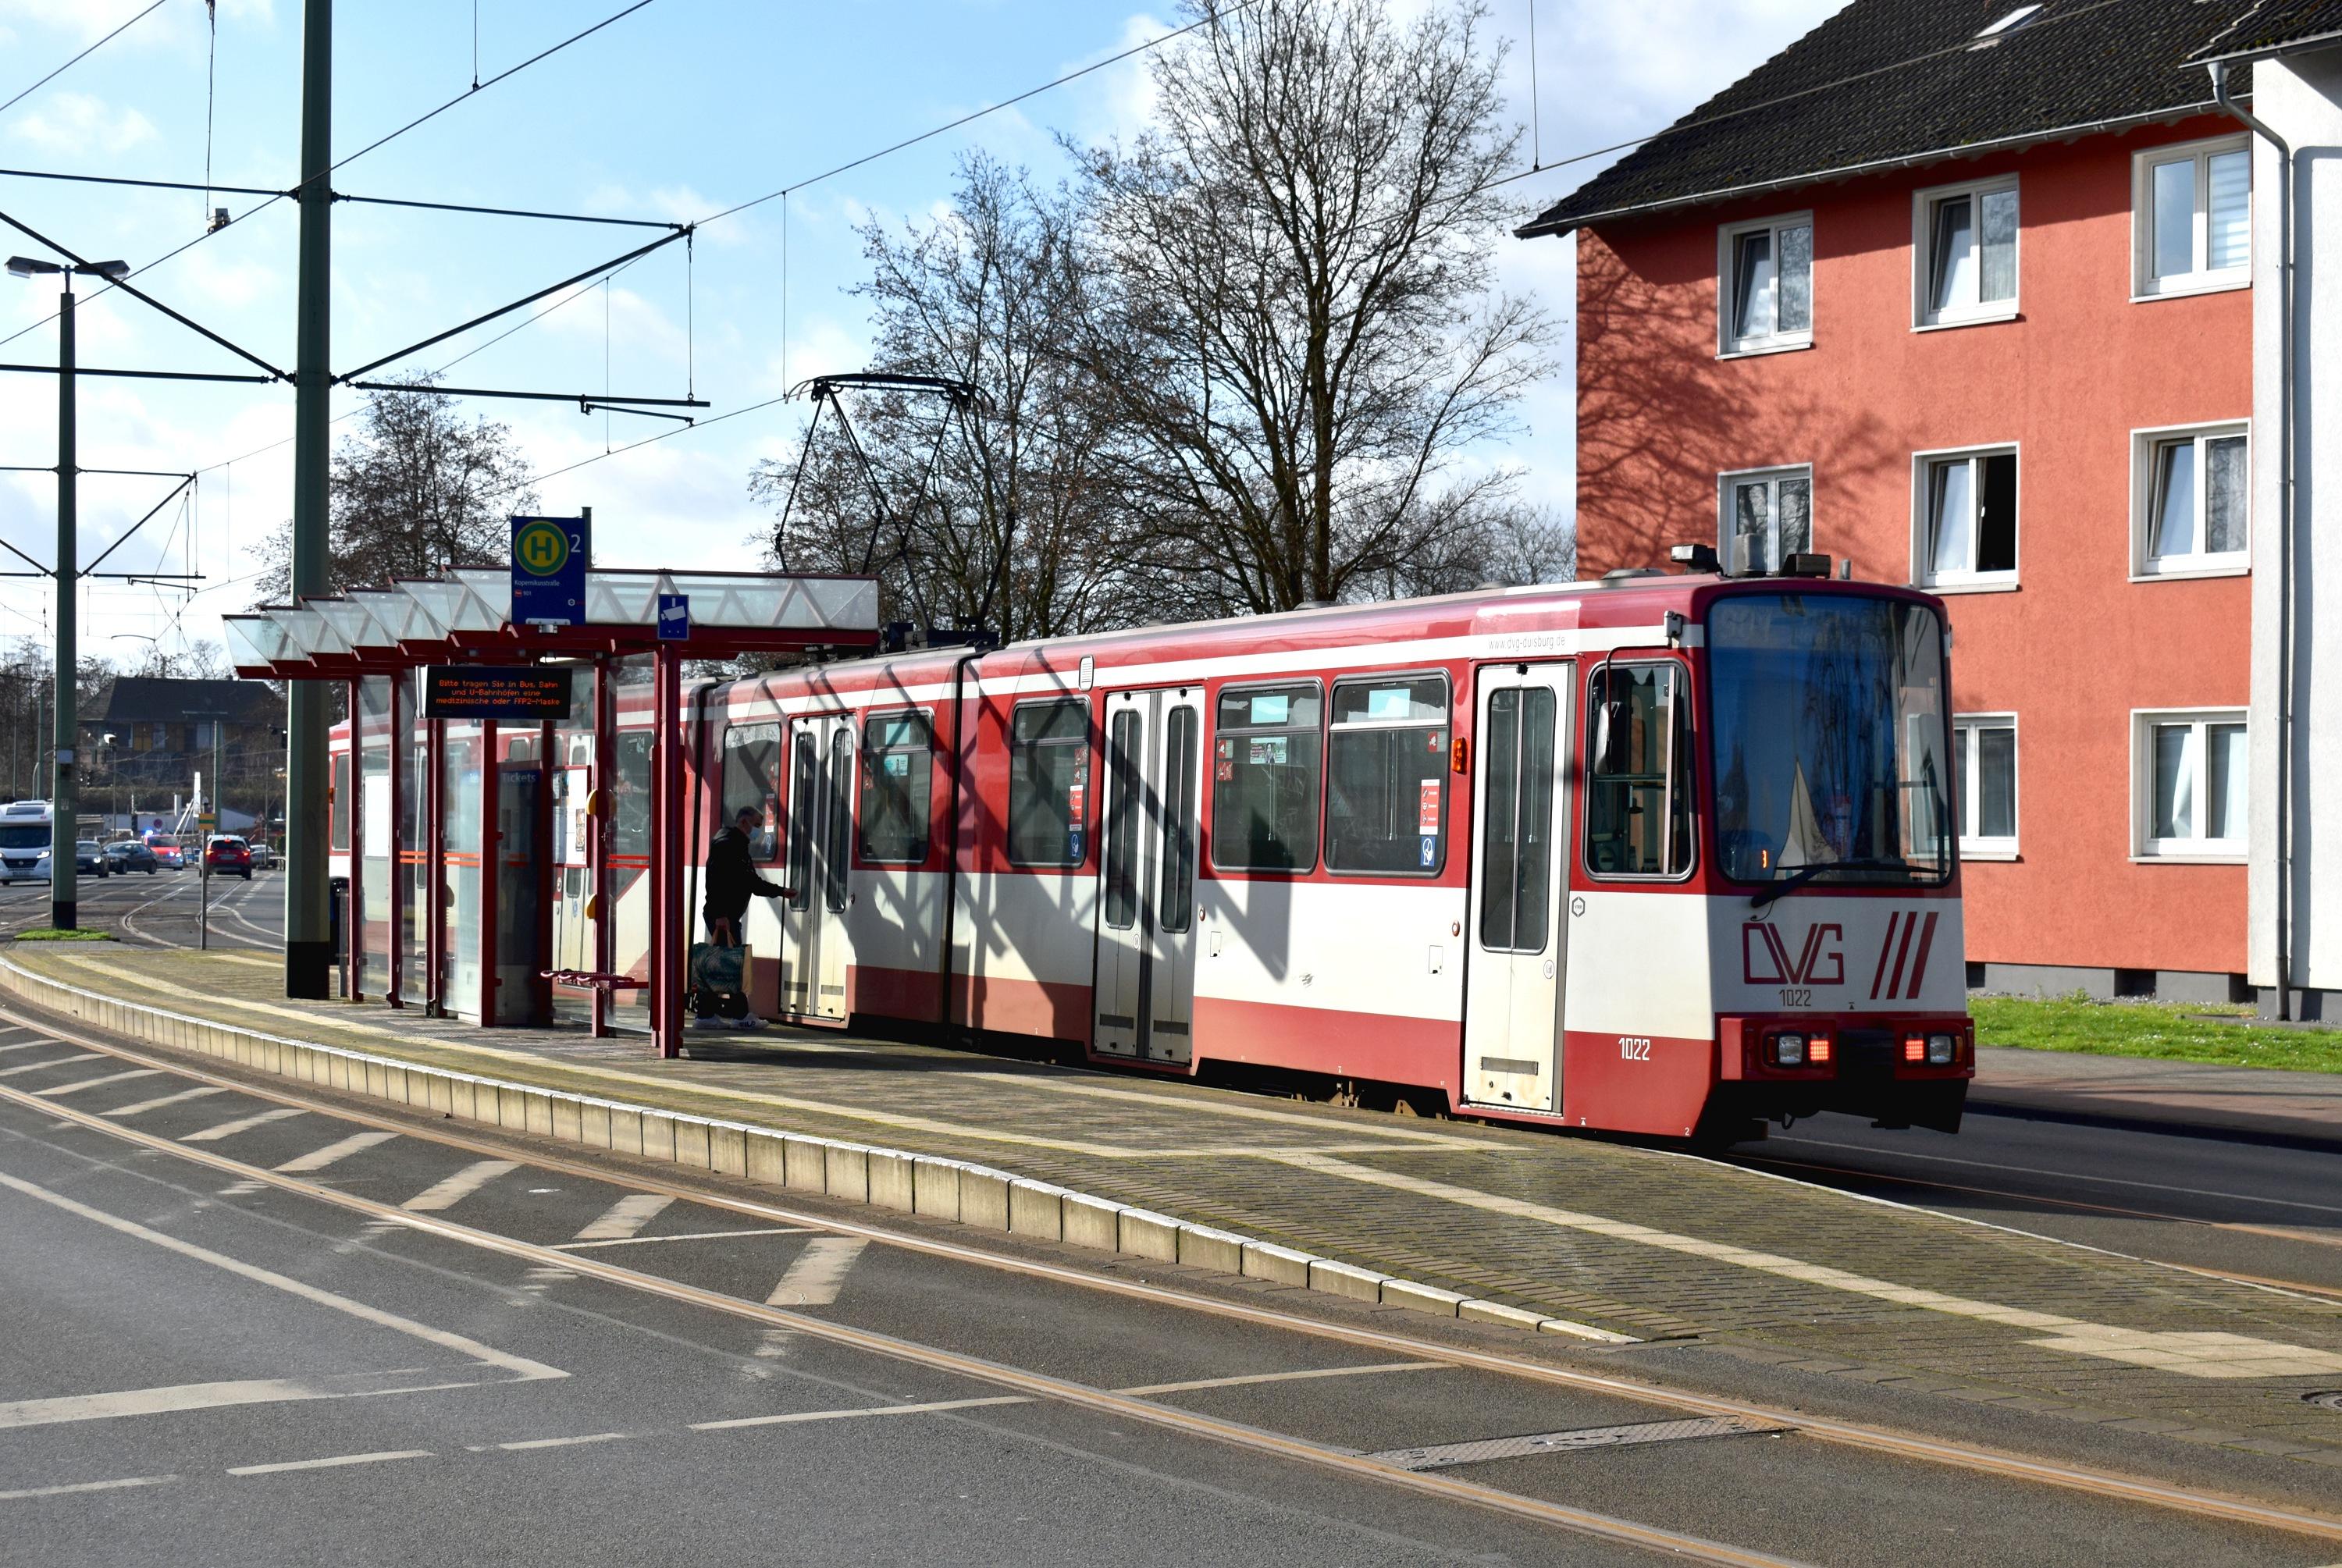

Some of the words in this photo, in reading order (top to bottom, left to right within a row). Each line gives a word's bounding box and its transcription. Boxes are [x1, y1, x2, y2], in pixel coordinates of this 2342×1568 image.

[532, 536, 552, 560] H
[571, 534, 581, 553] 2
[501, 773, 536, 782] Tickets
[1742, 923, 1845, 985] DVG
[1778, 989, 1812, 1007] 1022
[1618, 1037, 1650, 1061] 1022
[1685, 1127, 1690, 1136] 2
